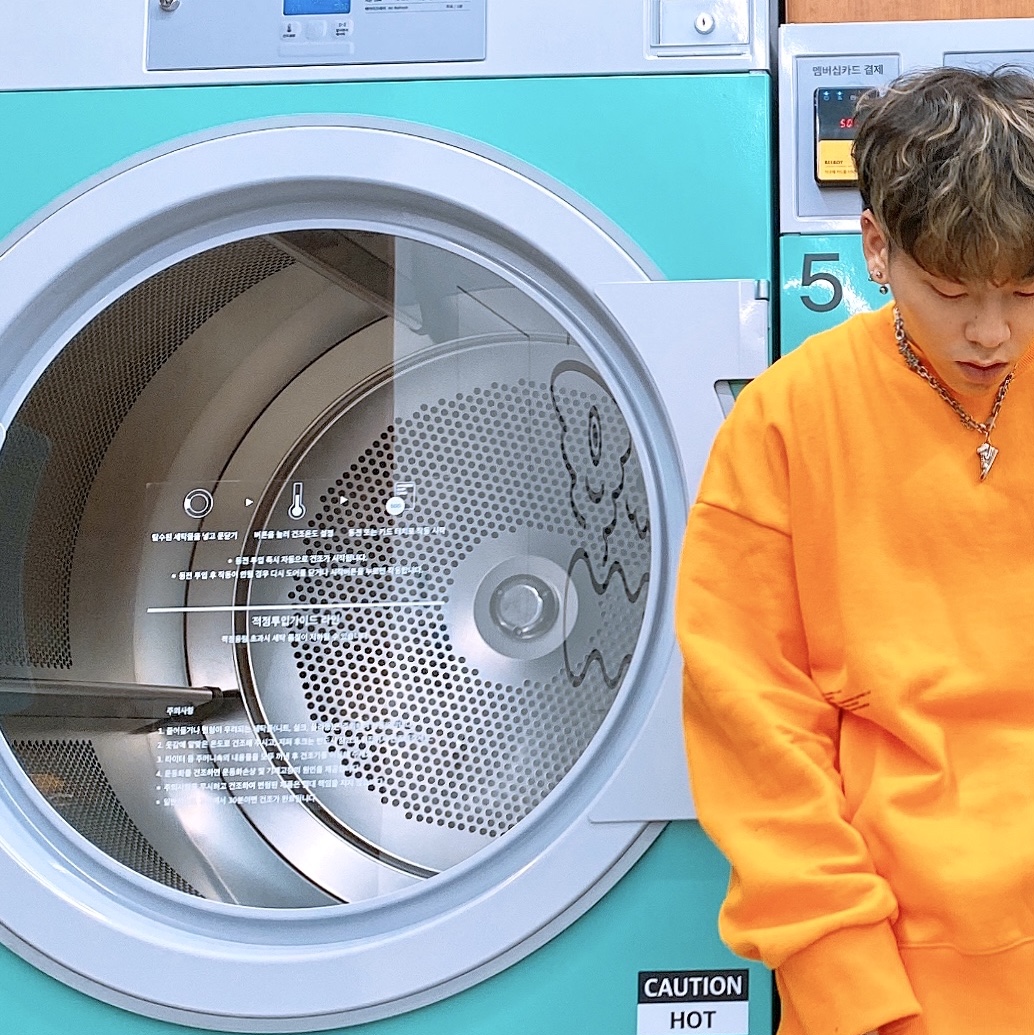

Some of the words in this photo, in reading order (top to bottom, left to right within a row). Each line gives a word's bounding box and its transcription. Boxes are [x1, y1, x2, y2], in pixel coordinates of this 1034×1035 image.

[812, 66, 861, 77] 멤버십카드
[864, 64, 884, 75] 결제
[800, 253, 843, 312] 5
[251, 615, 319, 627] 적정투입가이드
[321, 614, 340, 625] 라인
[166, 706, 194, 715] 주의사항
[644, 975, 742, 998] CAUTION
[670, 1010, 716, 1029] HOT
